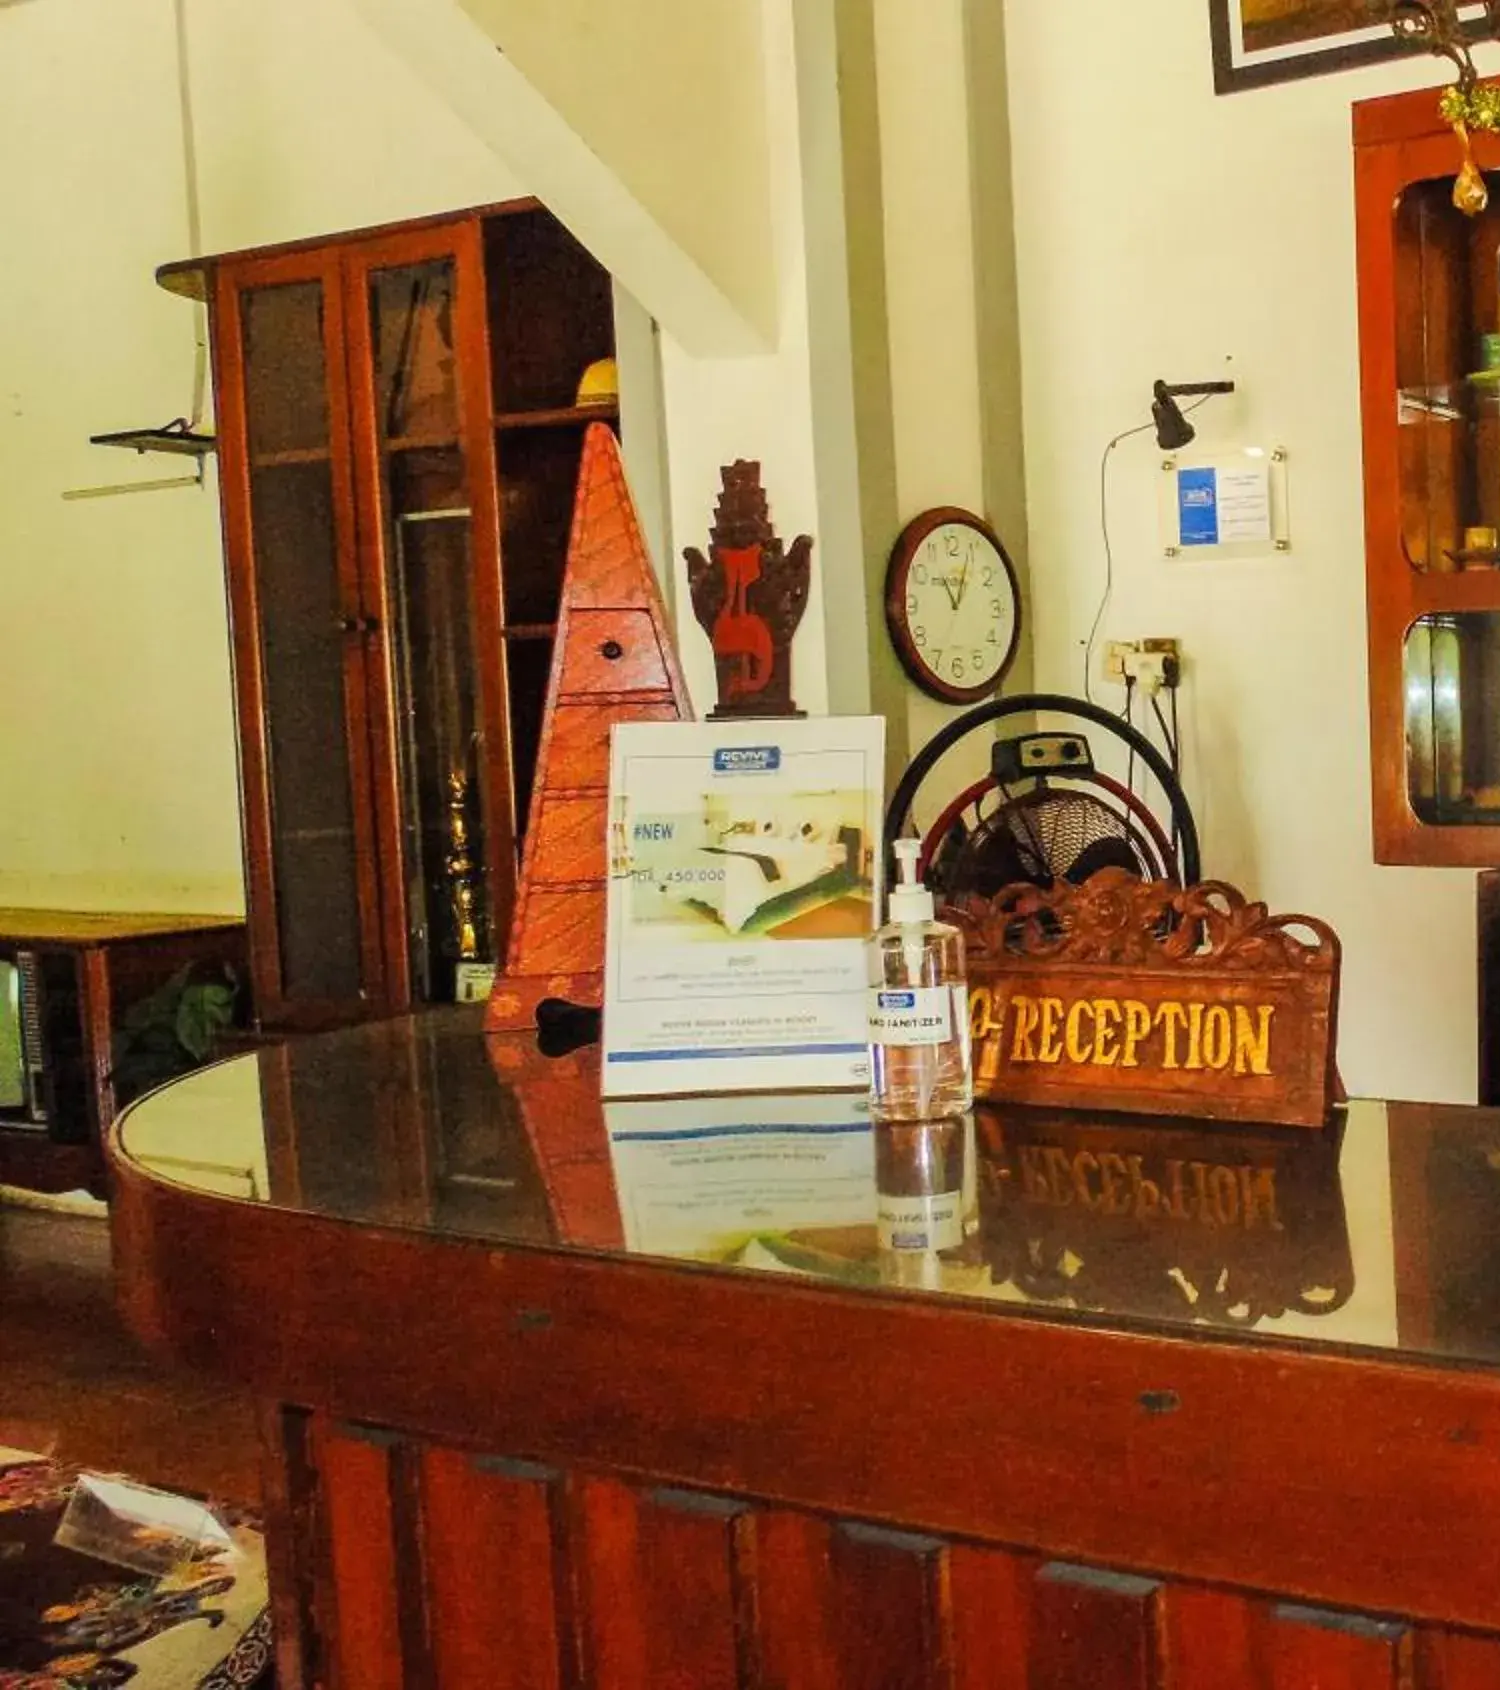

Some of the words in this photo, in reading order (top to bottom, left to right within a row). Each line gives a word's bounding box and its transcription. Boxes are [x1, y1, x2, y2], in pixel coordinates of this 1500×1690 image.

[944, 535, 959, 557] 12
[912, 563, 929, 585] 10
[982, 566, 993, 587] 2
[907, 594, 918, 615] 9
[991, 599, 1001, 619] 3
[914, 625, 927, 647] 8
[986, 627, 998, 644] 4
[931, 649, 943, 671] 7
[951, 657, 964, 679] 6
[972, 650, 984, 671] 5
[633, 824, 674, 840] #NEW
[1009, 997, 1275, 1076] RECEPTION
